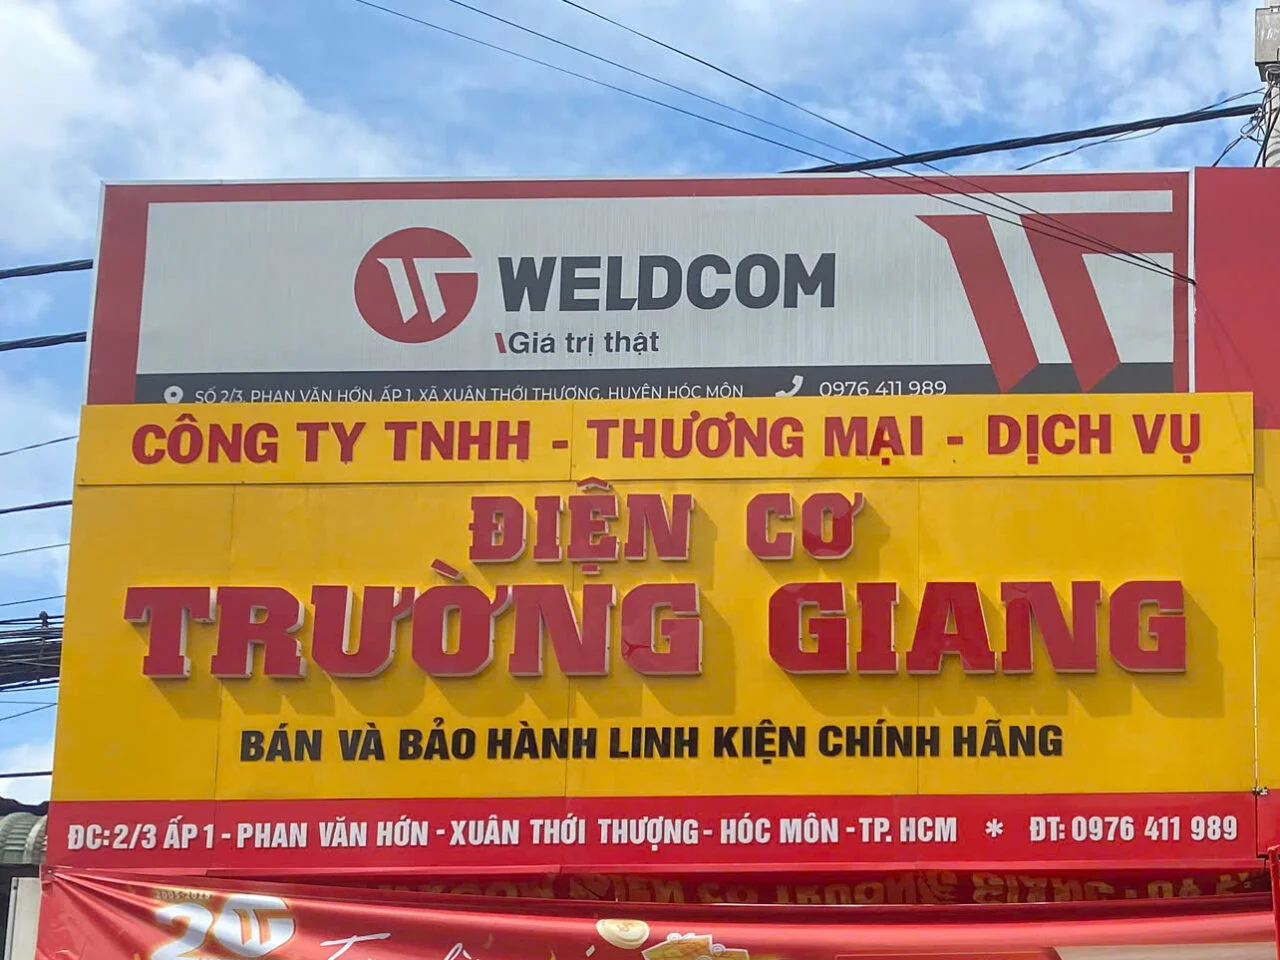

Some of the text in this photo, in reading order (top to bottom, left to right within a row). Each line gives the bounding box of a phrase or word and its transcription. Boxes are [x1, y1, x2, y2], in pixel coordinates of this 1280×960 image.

[498, 253, 837, 312] WELDCOM
[508, 330, 660, 357] Giá trị thật
[251, 388, 297, 402] PHAN
[300, 385, 334, 401] VĂN
[381, 384, 403, 401] ẤP
[420, 385, 441, 400] XÃ
[443, 384, 487, 401] XUÂN
[490, 384, 529, 401] THỚI
[668, 382, 702, 399] HÓC
[706, 382, 744, 398] MÔN
[819, 379, 947, 397] 0976 411 989
[132, 413, 278, 464] CÔNG
[297, 421, 366, 463] TY
[385, 420, 531, 462] TNHH
[587, 410, 803, 460] THƯƠNG
[824, 415, 923, 466] MẠI
[988, 414, 1112, 465] DỊCH
[1132, 414, 1201, 464] VỤ
[468, 476, 866, 575] ĐIỆN CƠ
[124, 558, 1187, 680] TRƯỜNG GIANG
[240, 716, 1065, 765] BÁN VÀ BẢO HÀNH LINH KIỆN CHÍNH HÃNG
[237, 821, 308, 849] PHAN
[319, 816, 368, 848] VĂN
[376, 816, 429, 848] HỚN
[450, 814, 521, 847] XUÂN
[531, 812, 587, 846] THỚI
[599, 814, 699, 852] THƯỢNG
[720, 811, 772, 845] HÓC
[780, 812, 839, 844] MÔN
[860, 817, 893, 844] TP.
[900, 817, 958, 843] HCM
[1030, 817, 1066, 842] ĐT:
[1072, 816, 1135, 842] 0976
[1144, 816, 1181, 841] 411
[1191, 815, 1238, 841] 989
